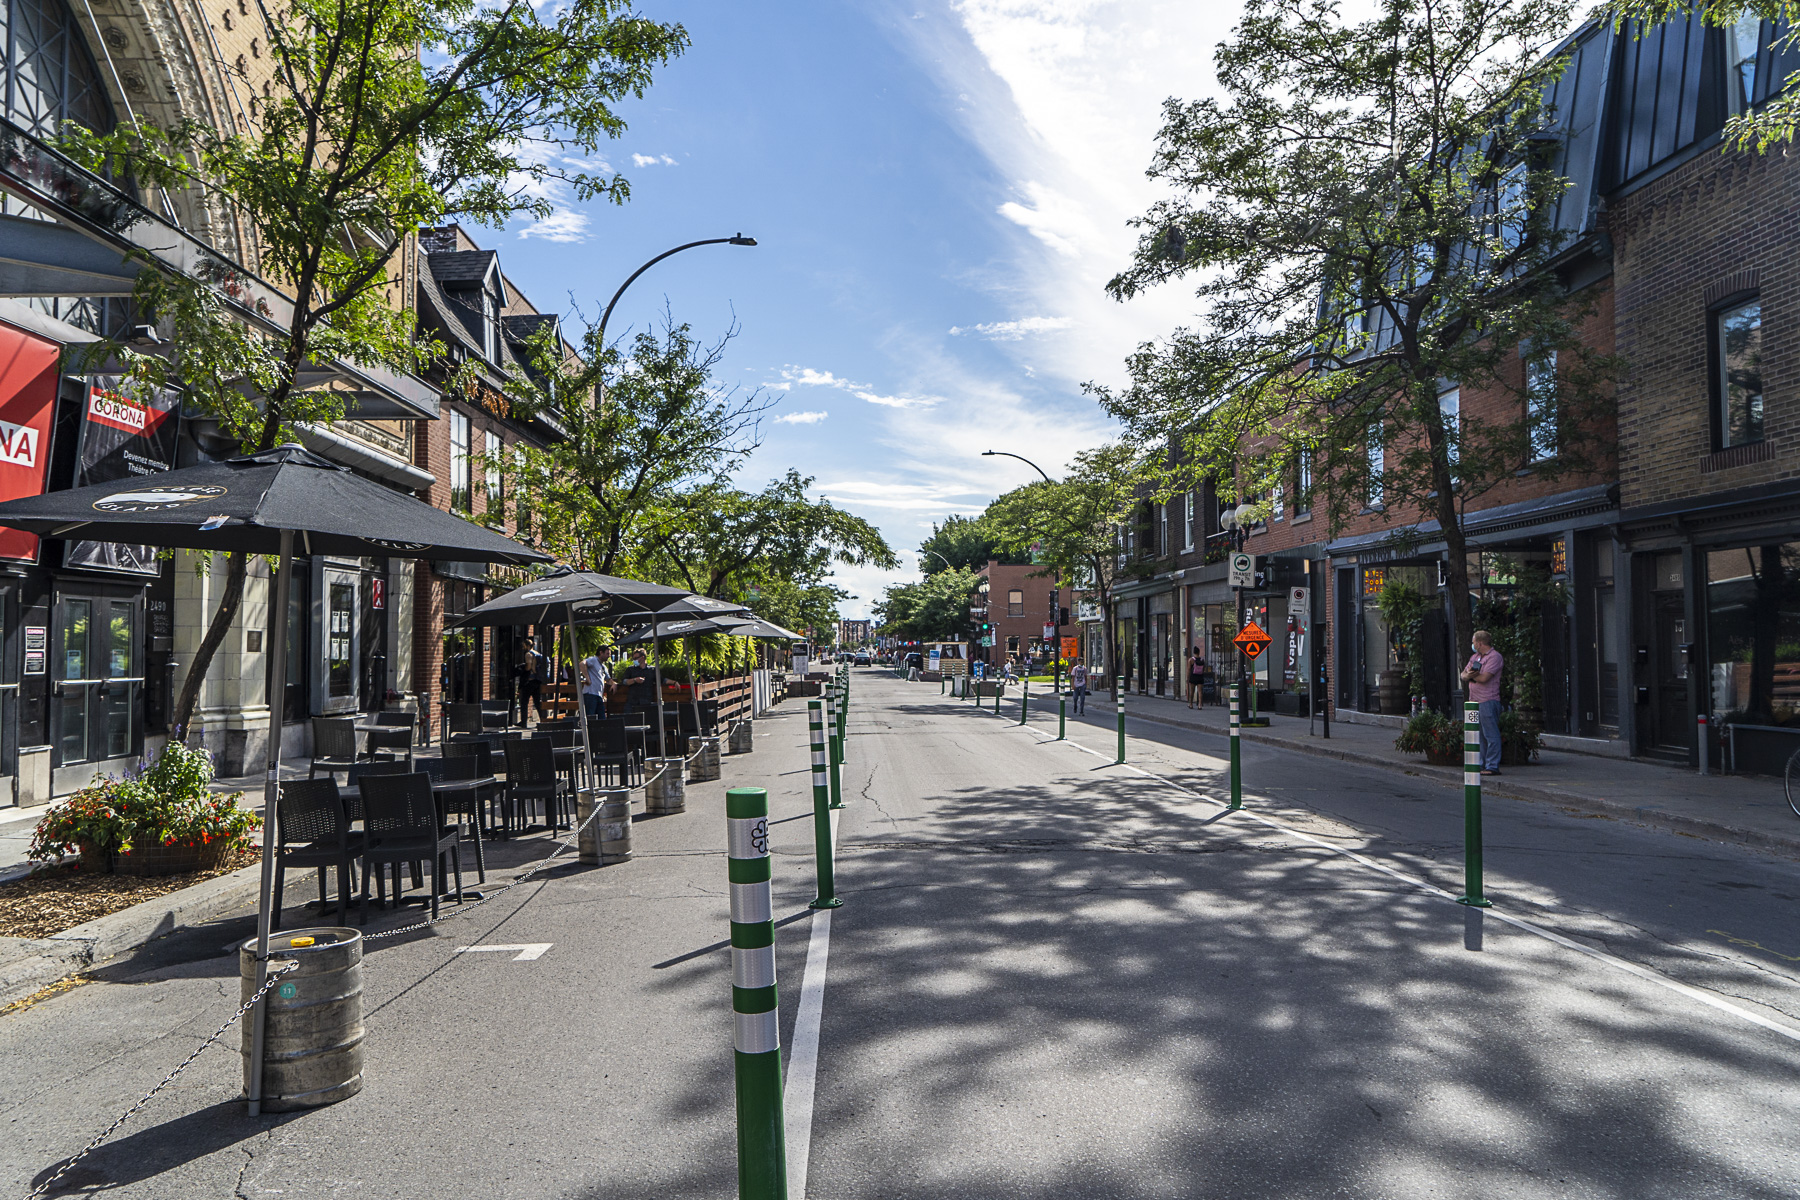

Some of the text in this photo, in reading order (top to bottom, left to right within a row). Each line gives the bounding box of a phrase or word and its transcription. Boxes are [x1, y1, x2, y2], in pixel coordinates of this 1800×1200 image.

[94, 399, 144, 427] CORONA
[123, 449, 170, 472] Devenez membre
[127, 462, 149, 476] Théâtre
